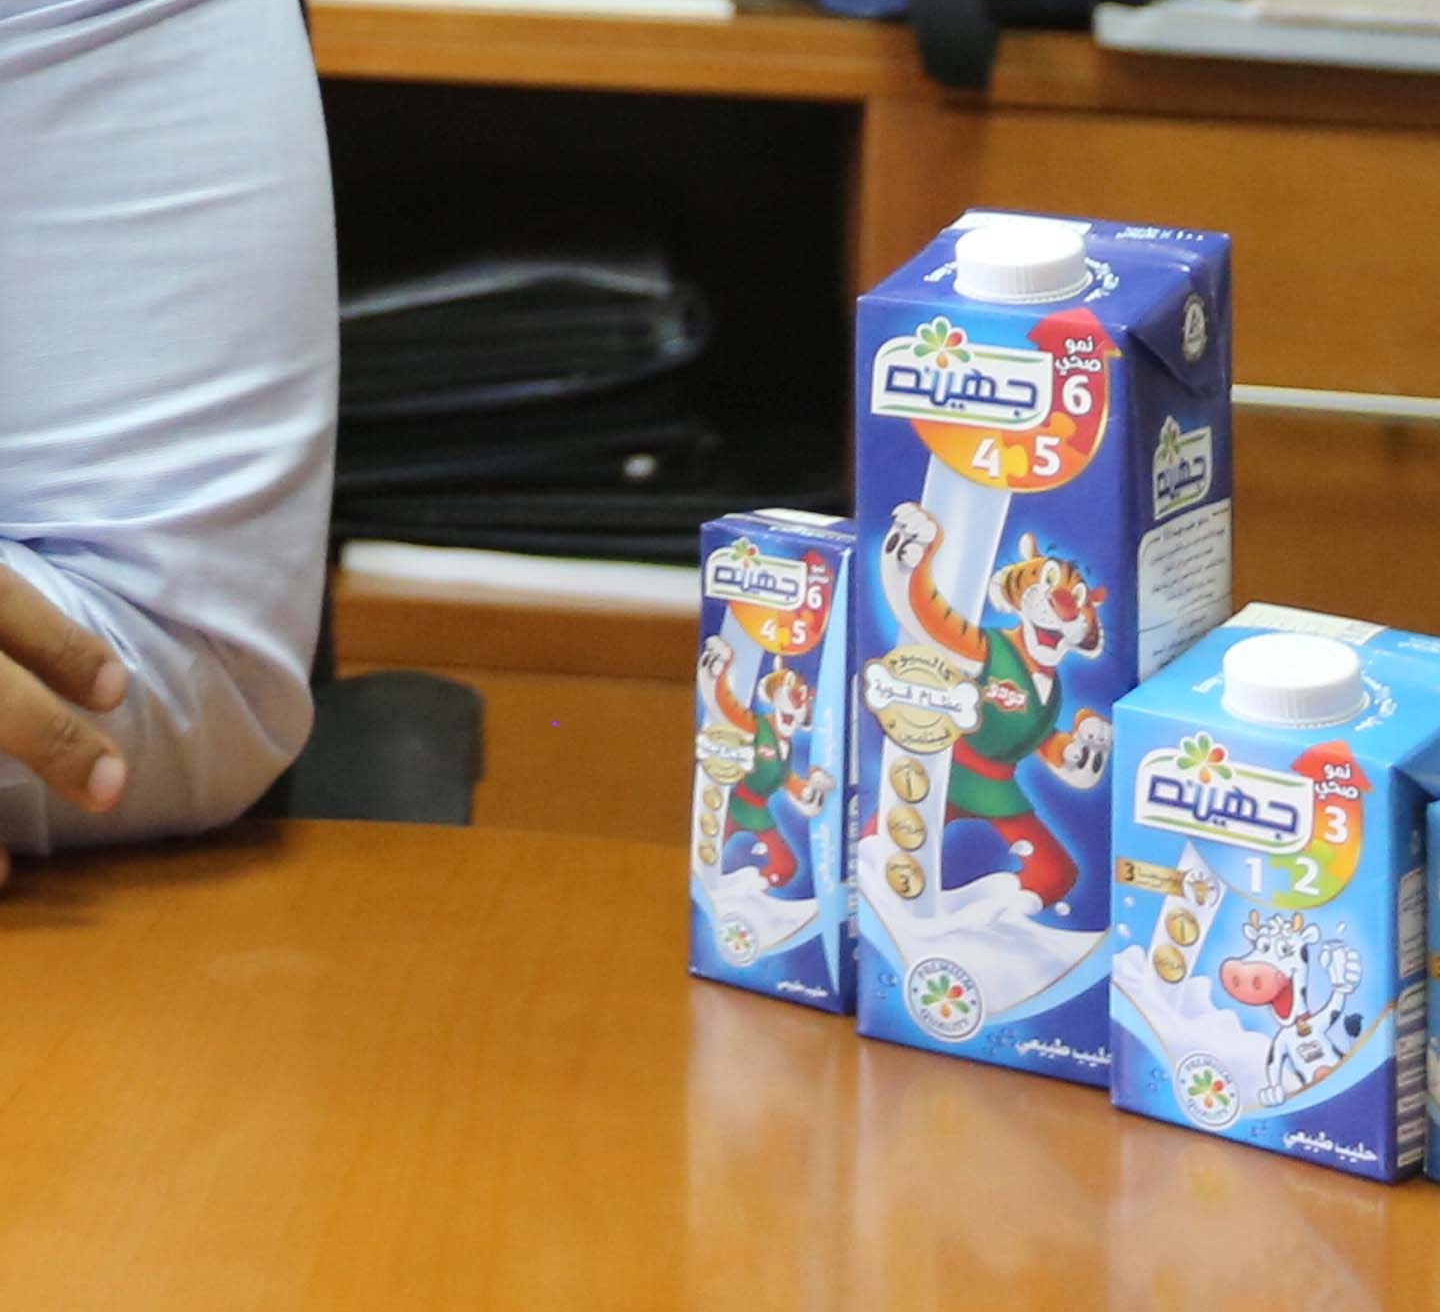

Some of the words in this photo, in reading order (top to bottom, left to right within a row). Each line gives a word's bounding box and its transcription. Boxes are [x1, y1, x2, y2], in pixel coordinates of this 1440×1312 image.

[1061, 375, 1092, 415] 6
[971, 438, 1001, 478] 4
[1031, 436, 1062, 476] 5
[806, 586, 822, 609] 6
[760, 620, 776, 641] 4
[791, 620, 807, 644] 5
[1323, 806, 1349, 844] 3
[1244, 857, 1264, 893] 1
[1293, 857, 1320, 895] 2
